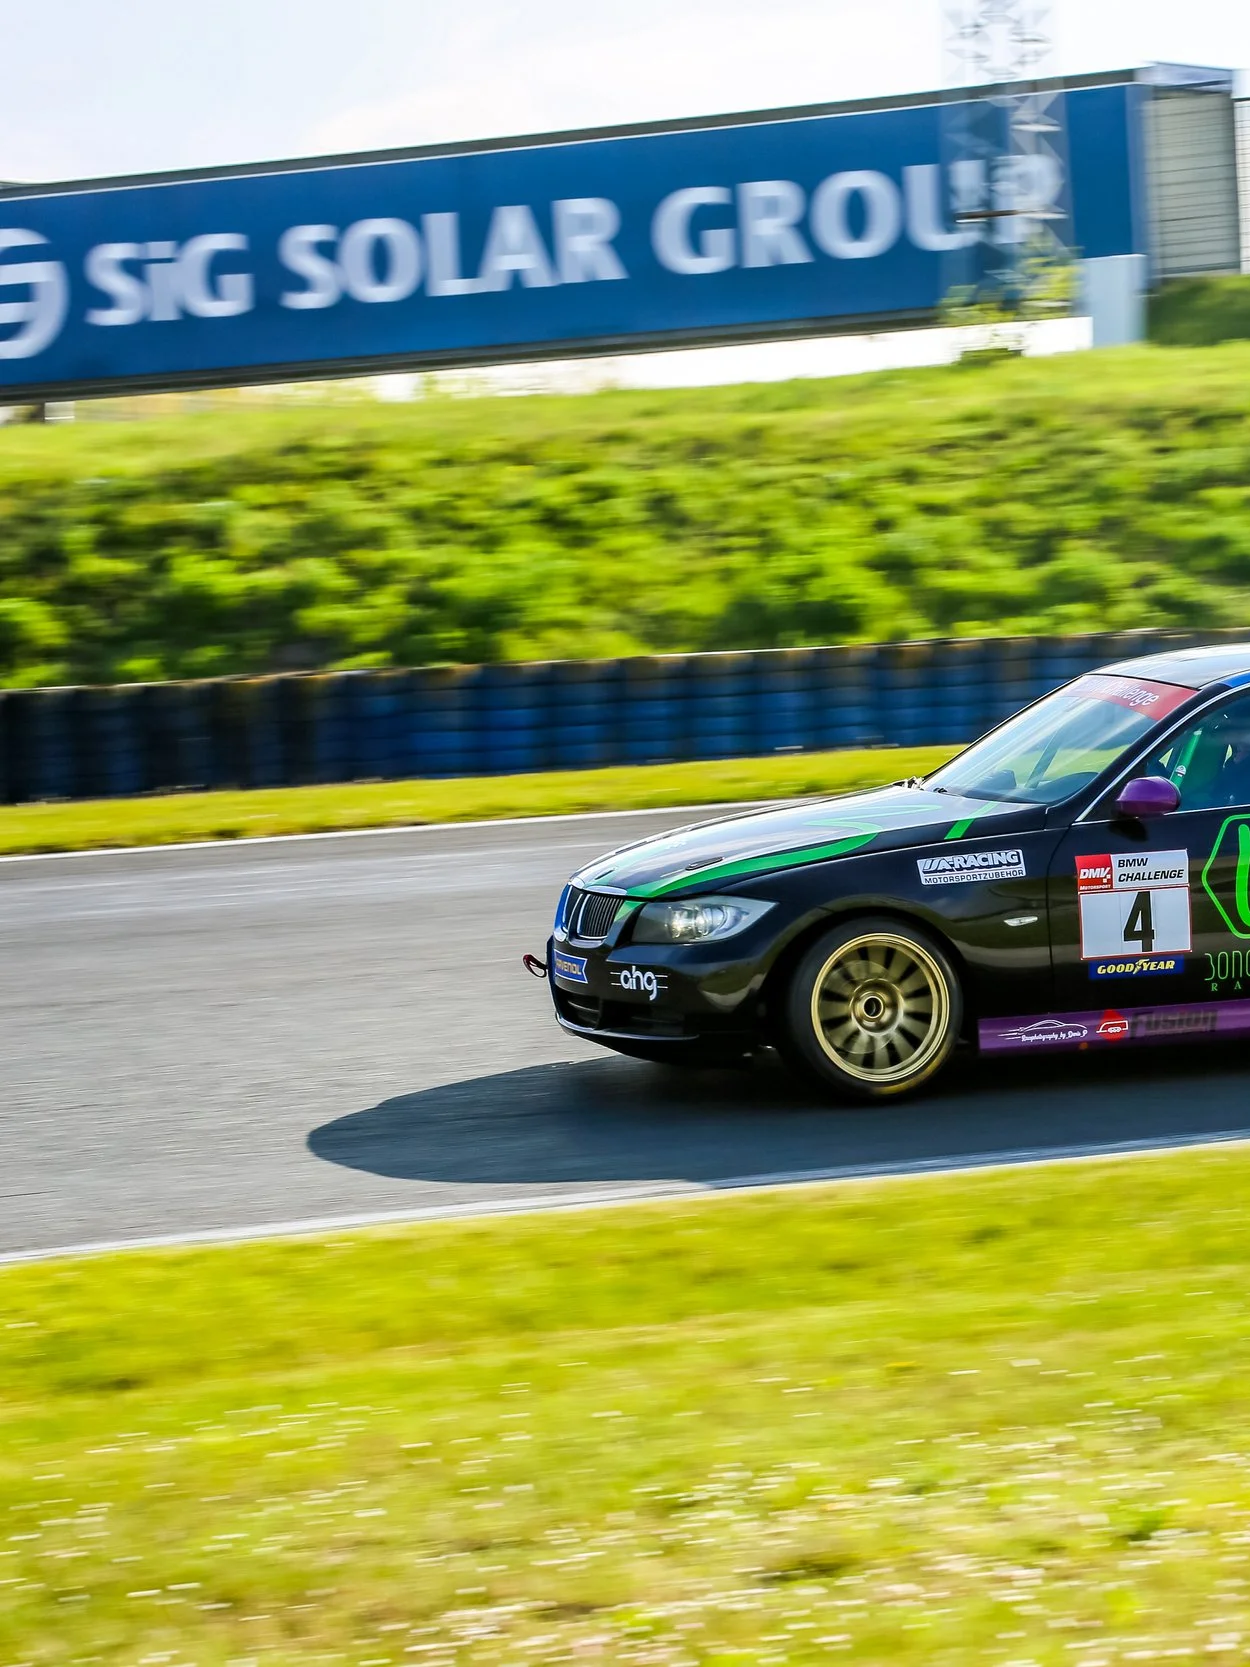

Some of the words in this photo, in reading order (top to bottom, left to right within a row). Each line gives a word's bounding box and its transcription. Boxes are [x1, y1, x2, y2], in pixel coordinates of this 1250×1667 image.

[278, 196, 630, 310] SOLAR
[651, 154, 1064, 275] GROUP
[1118, 858, 1149, 868] BMW
[1118, 869, 1184, 883] CHALLENGE
[1123, 890, 1155, 953] 4
[1097, 959, 1175, 975] GOODYEAR
[620, 965, 657, 1001] ahg
